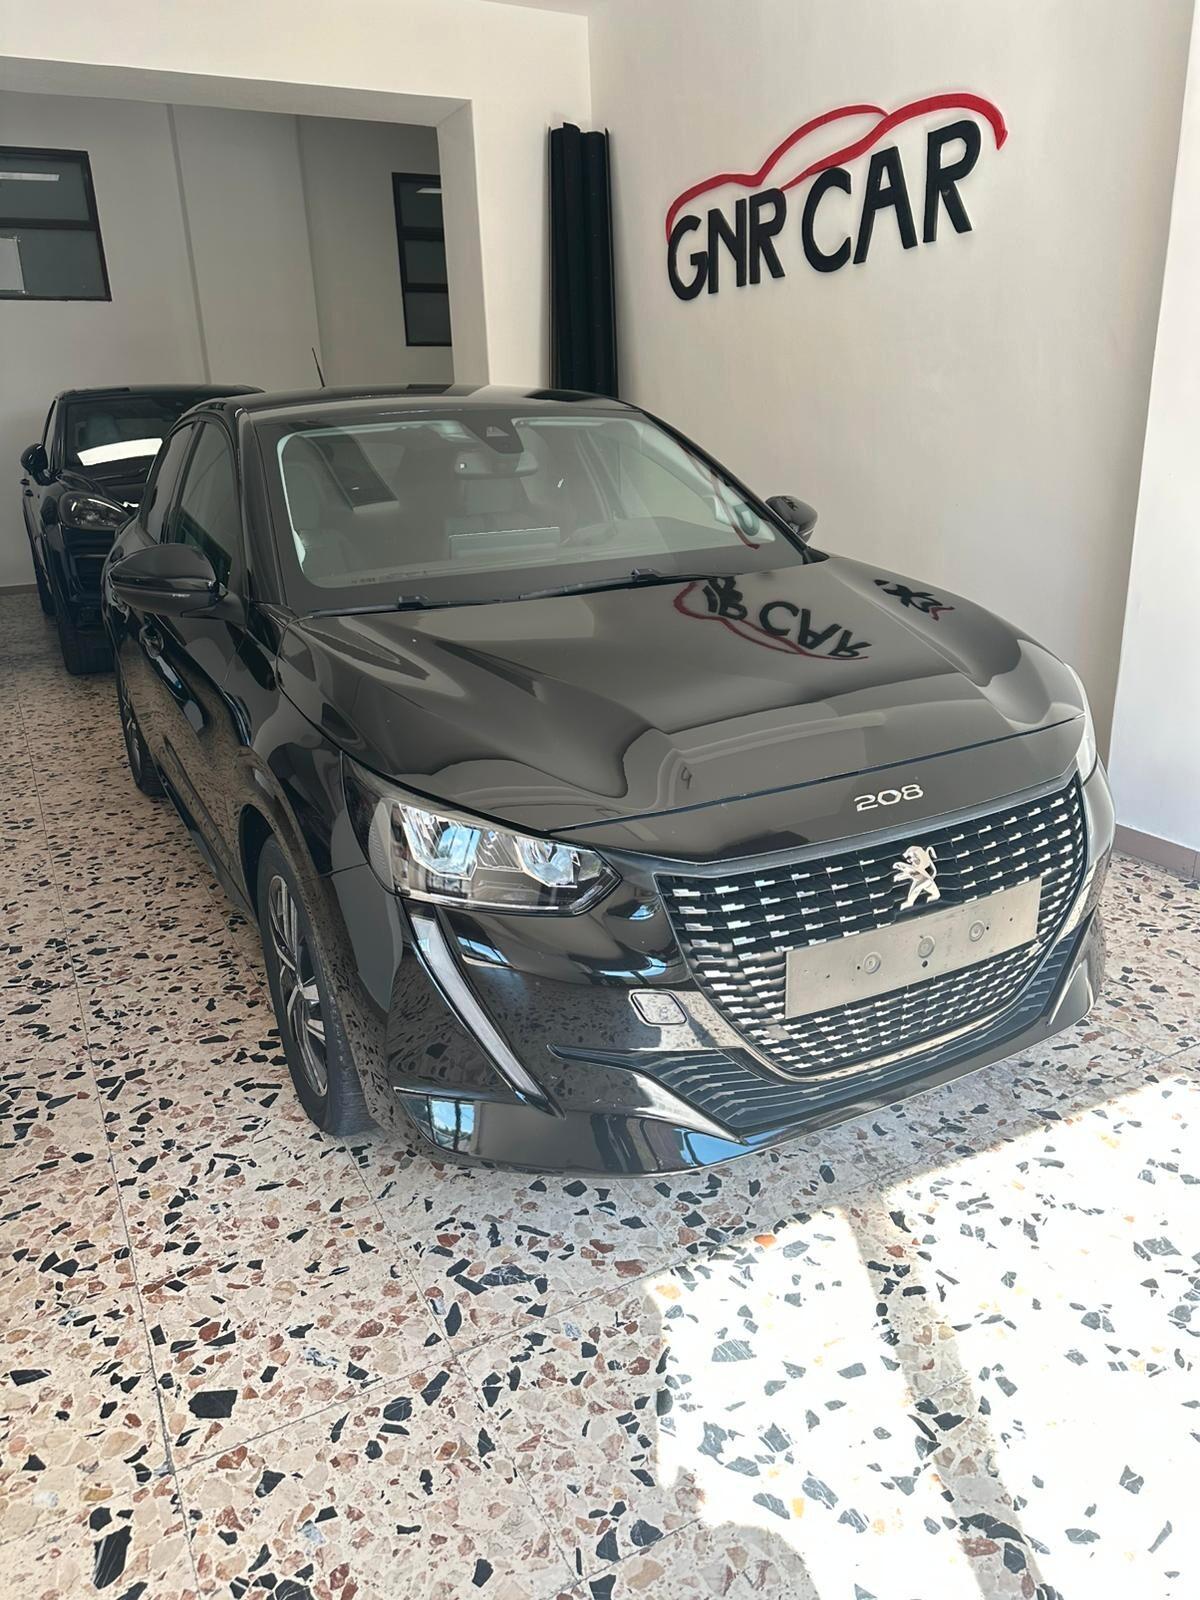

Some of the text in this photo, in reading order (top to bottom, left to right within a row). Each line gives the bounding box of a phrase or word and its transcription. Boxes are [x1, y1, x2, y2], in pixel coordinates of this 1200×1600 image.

[667, 119, 982, 301] GNR CAR
[854, 784, 924, 812] 208
